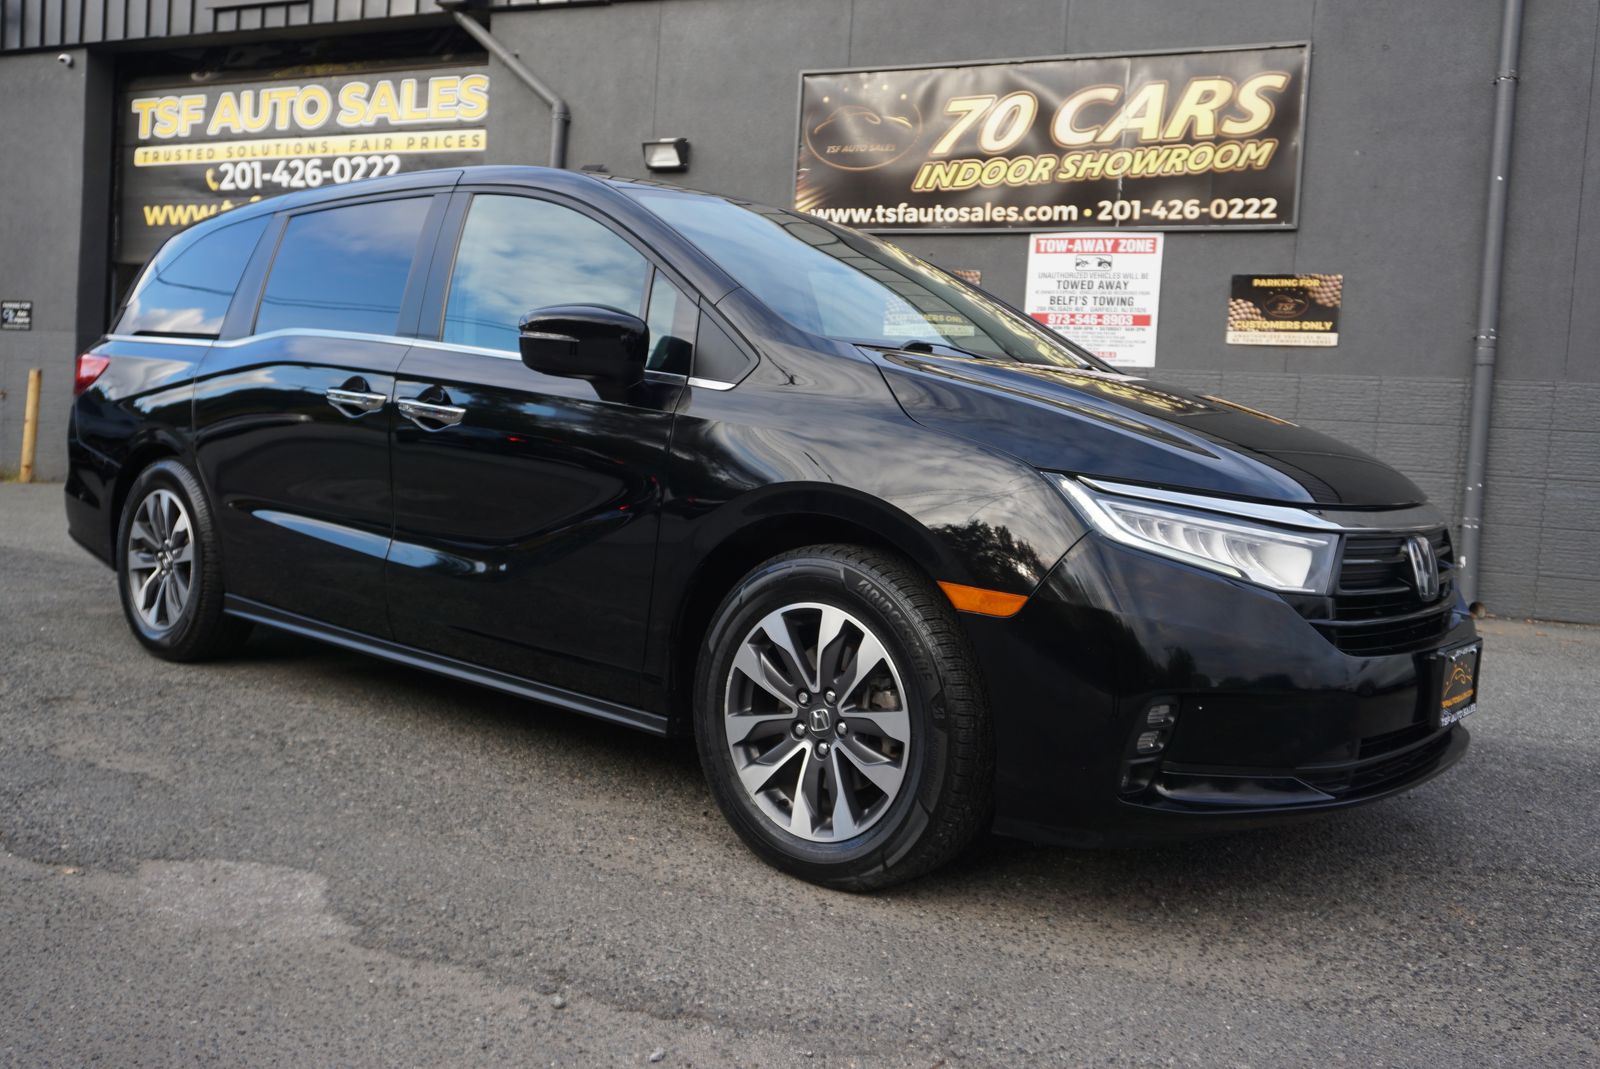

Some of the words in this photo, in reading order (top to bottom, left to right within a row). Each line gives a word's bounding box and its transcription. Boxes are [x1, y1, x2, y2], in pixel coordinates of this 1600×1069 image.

[132, 95, 207, 139] TSF
[207, 85, 332, 135] AUTO
[337, 74, 489, 127] SALES
[929, 92, 1038, 156] 70
[1051, 71, 1291, 149] CARS
[143, 148, 216, 163] TRUSTED
[226, 141, 337, 159] SOLUTIONS,
[349, 138, 393, 152] FAIR
[407, 134, 480, 149] PRICES
[842, 144, 866, 153] AUTO
[868, 144, 896, 152] SALES
[911, 153, 1058, 191] INDOOR
[1056, 139, 1279, 181] SHOWROOM
[219, 154, 400, 190] 201-426-0222
[811, 202, 1078, 224] www.tsfautosales.com
[1097, 197, 1278, 220] 201-426-0222
[1038, 239, 1114, 252] TOW-AWAY
[1117, 240, 1154, 252] ZONE
[1056, 280, 1094, 290] TOWED
[1097, 280, 1129, 290] AWAY
[1252, 279, 1299, 287] PARKING
[1299, 279, 1321, 287] FOR
[1049, 296, 1088, 306] BELFI'S
[1093, 296, 1135, 306] TOWING
[1047, 314, 1133, 326] 973-546-8903
[1235, 321, 1301, 330] CUSTOMERS
[1301, 321, 1333, 330] ONLY
